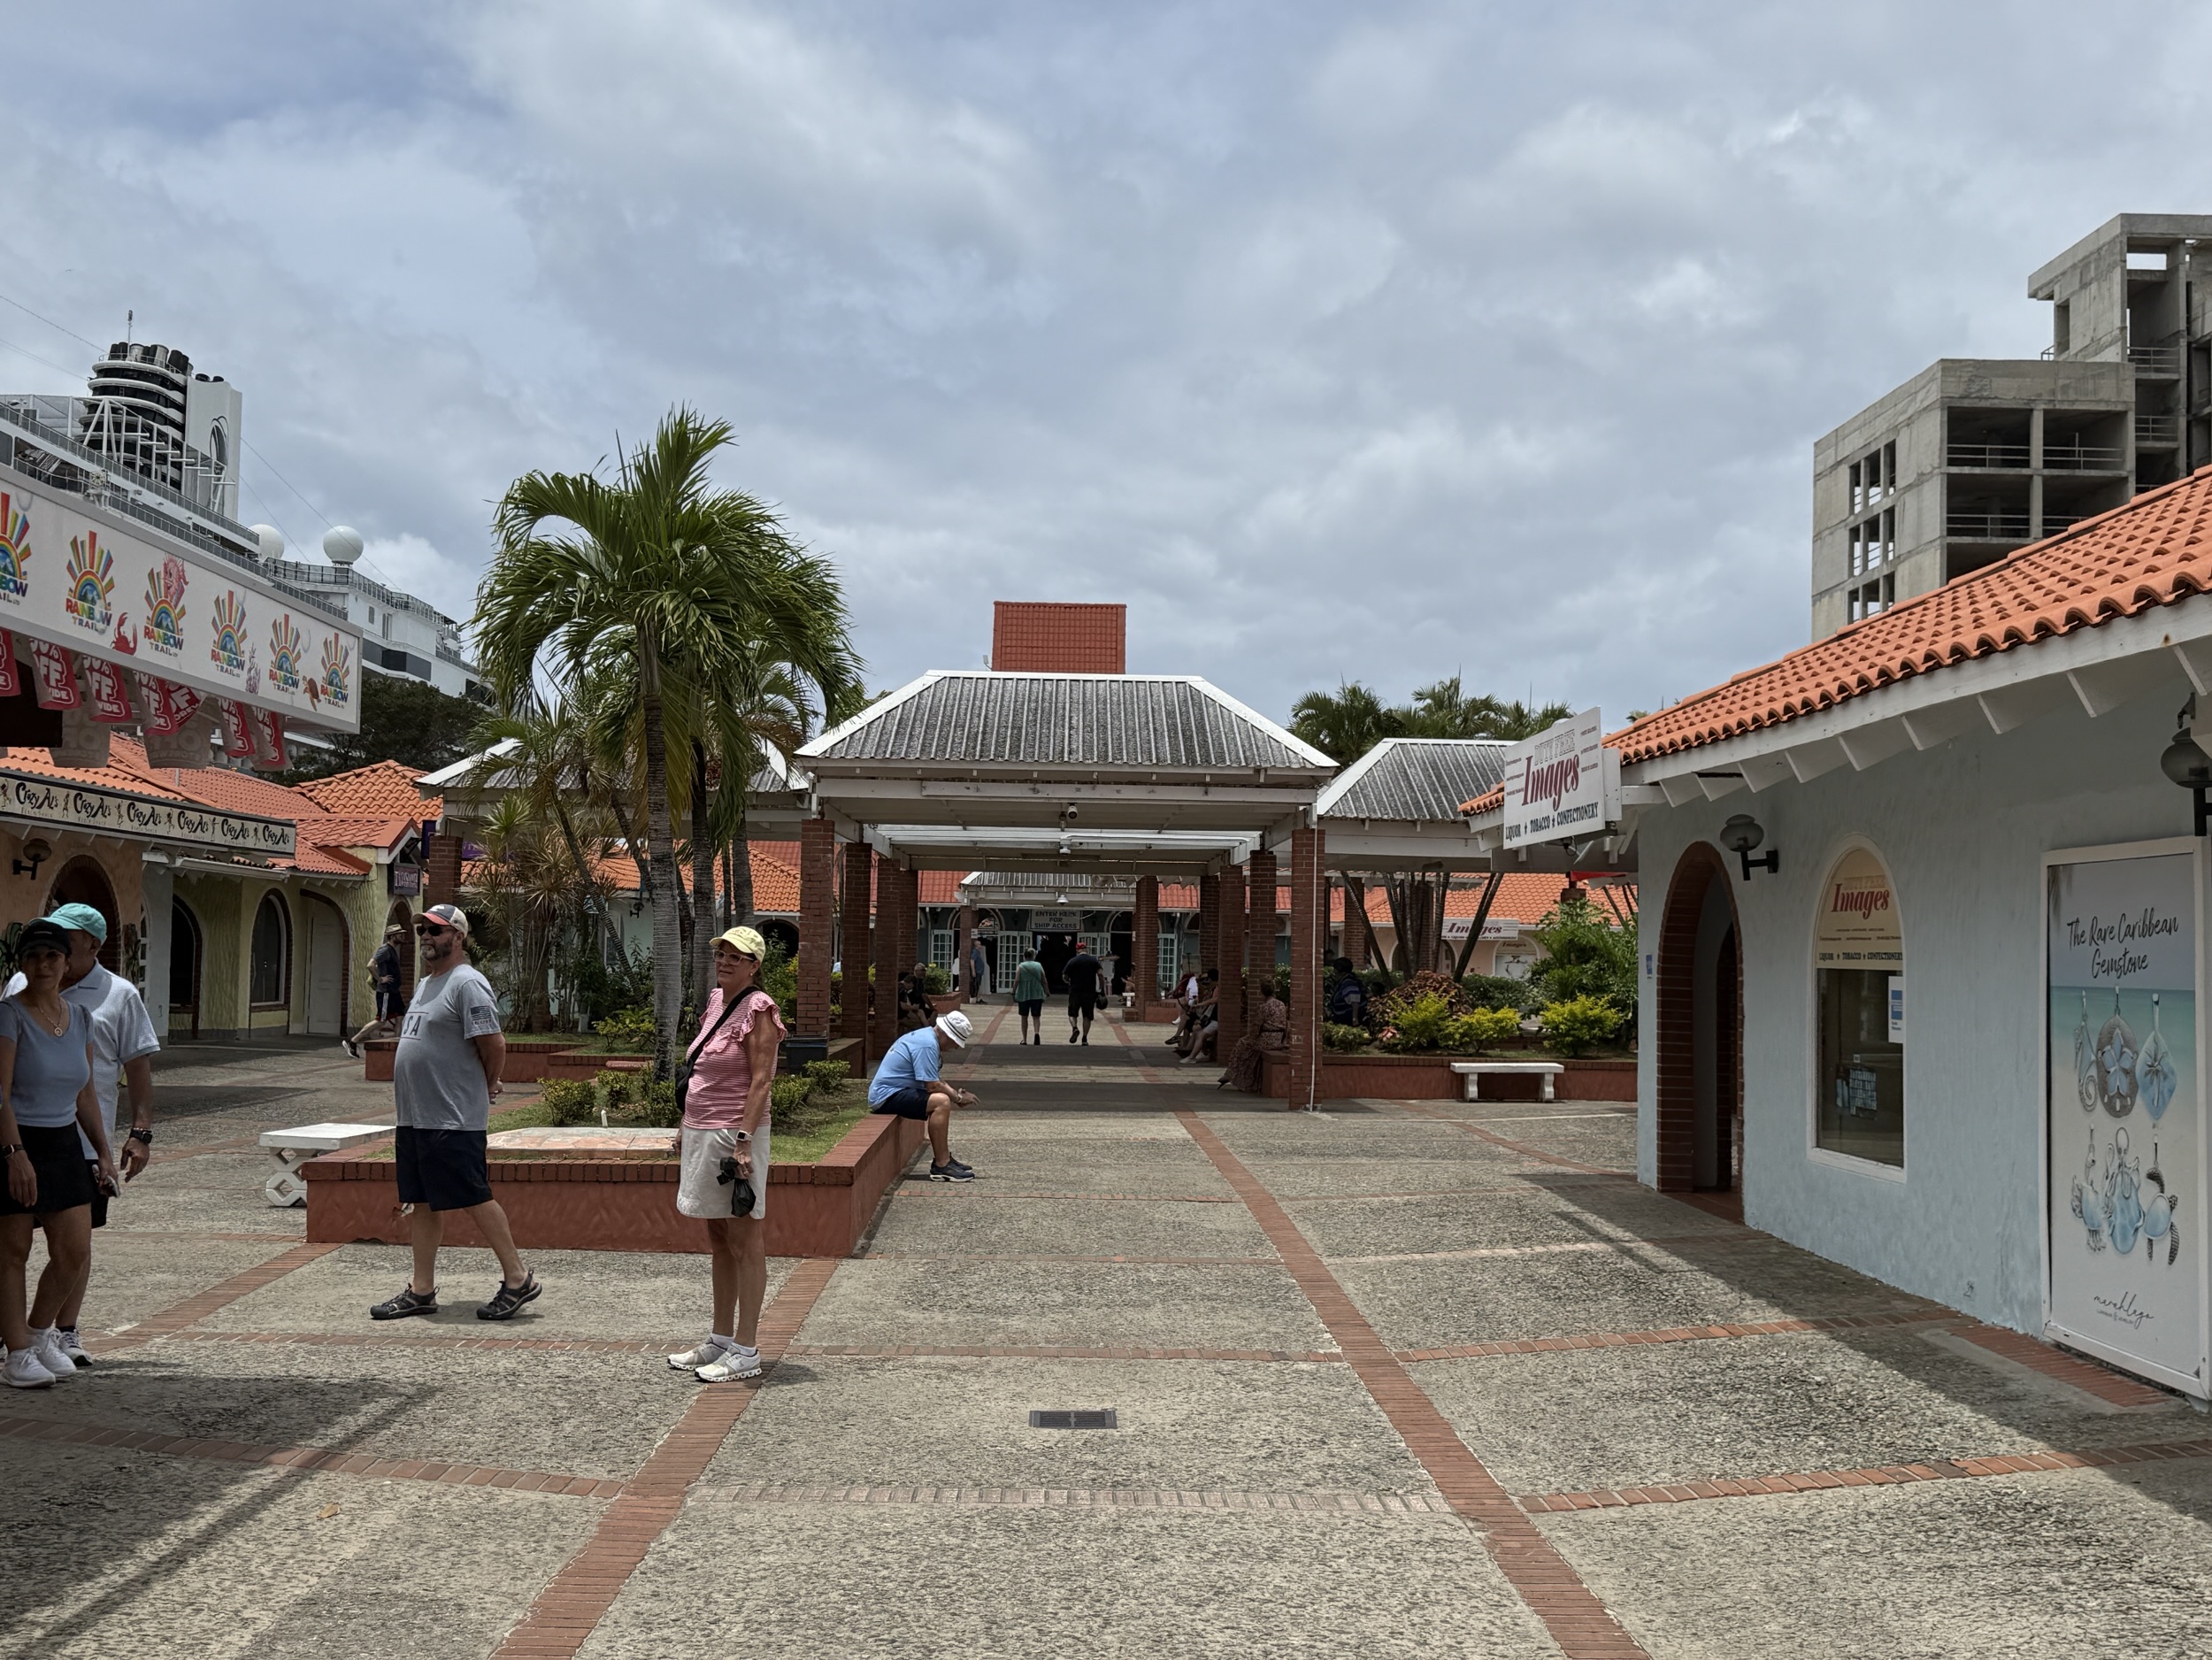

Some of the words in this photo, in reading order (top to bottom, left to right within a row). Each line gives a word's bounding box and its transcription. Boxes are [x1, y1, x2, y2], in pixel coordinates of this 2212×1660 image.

[65, 597, 112, 626] RAINBOW
[72, 615, 99, 632] TRAIL
[144, 625, 184, 650] RAINBOW
[149, 642, 173, 656] TRAIL
[211, 649, 246, 671] RAINBOW
[215, 664, 236, 677] TRAIL
[268, 668, 300, 689] RAINBOW
[273, 682, 292, 696] TRAIL
[320, 683, 349, 703] RAINBOW
[324, 696, 342, 708] TRAIL
[1522, 754, 1580, 811] Images
[15, 782, 40, 809] Crazy
[73, 792, 95, 818] Crazy
[127, 802, 146, 826] Crazy
[178, 811, 196, 834] Crazy
[1505, 824, 1522, 842] LIQUOR
[1530, 815, 1551, 834] TOBACCO
[1556, 802, 1599, 826] CONFECTIONERY
[221, 818, 237, 841] Crazy
[263, 825, 278, 846] Crazy
[1831, 883, 1890, 920] Images
[1447, 923, 1503, 936] Imges
[2067, 917, 2086, 950] The
[2088, 915, 2116, 947] Rare
[2117, 906, 2179, 944] Caribbean
[2091, 947, 2149, 980] Gemstone
[403, 1015, 422, 1037] SA
